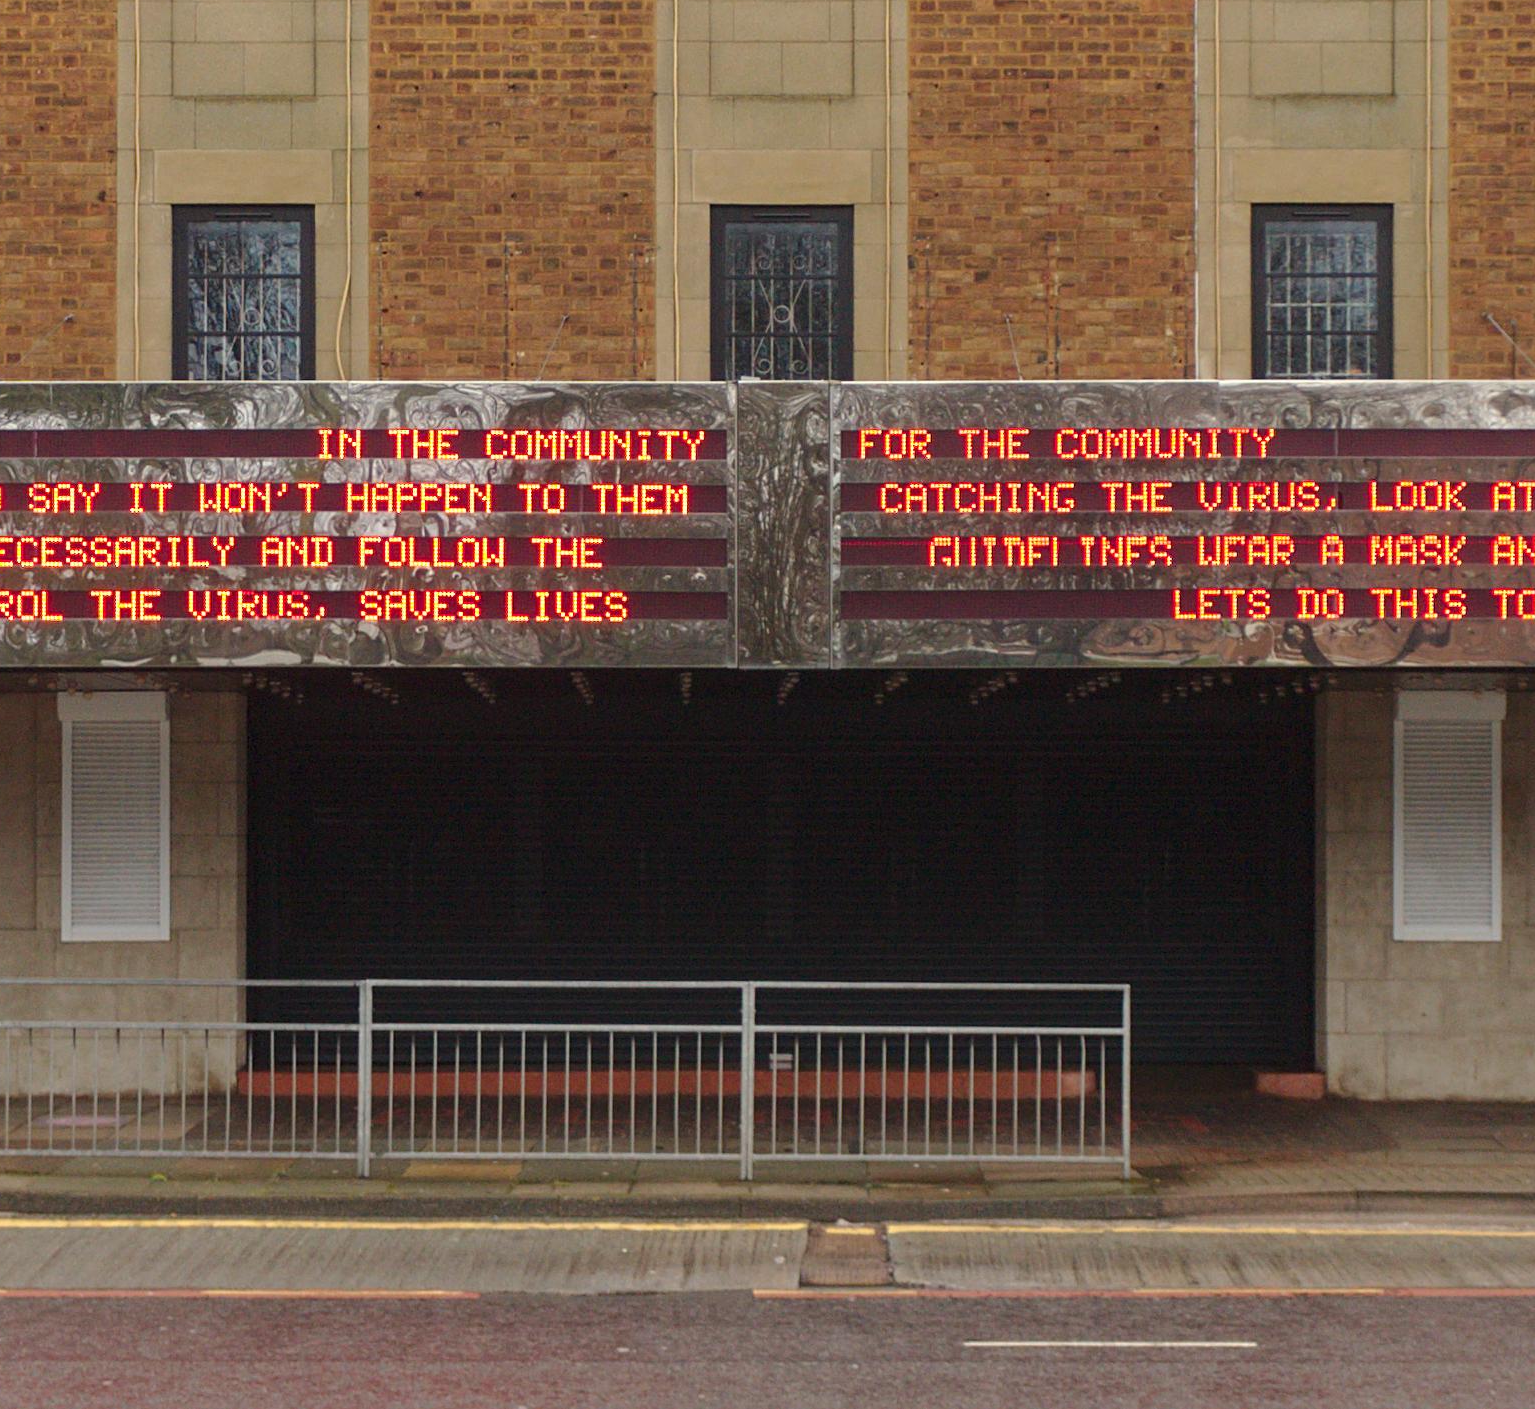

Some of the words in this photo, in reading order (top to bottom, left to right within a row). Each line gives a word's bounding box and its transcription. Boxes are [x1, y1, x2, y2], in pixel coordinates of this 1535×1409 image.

[318, 427, 362, 460] IN
[388, 427, 459, 461] THE
[484, 429, 705, 463] COMMUNITY
[858, 427, 932, 460] FOR
[958, 427, 1030, 460] THE
[1054, 427, 1275, 460] COMMUNITY
[28, 482, 100, 514] SAY
[129, 481, 172, 514] IT
[199, 480, 321, 515] WON'T
[346, 480, 492, 514] HAPPEN
[518, 483, 565, 515] TO
[591, 482, 688, 515] THEM
[880, 481, 1075, 514] CATCHING
[1101, 482, 1173, 513] THE
[1368, 480, 1467, 513] LOOK
[260, 536, 333, 568] AND
[358, 534, 505, 570] FOLLOW
[531, 535, 604, 569] THE
[1319, 534, 1344, 566] A
[1368, 534, 1467, 566] MASK
[90, 588, 162, 621] THE
[360, 588, 481, 623] SAVES
[505, 589, 628, 623] LIVES
[1172, 587, 1271, 620] LETS
[1296, 587, 1344, 620] DO
[1370, 588, 1467, 620] THIS
